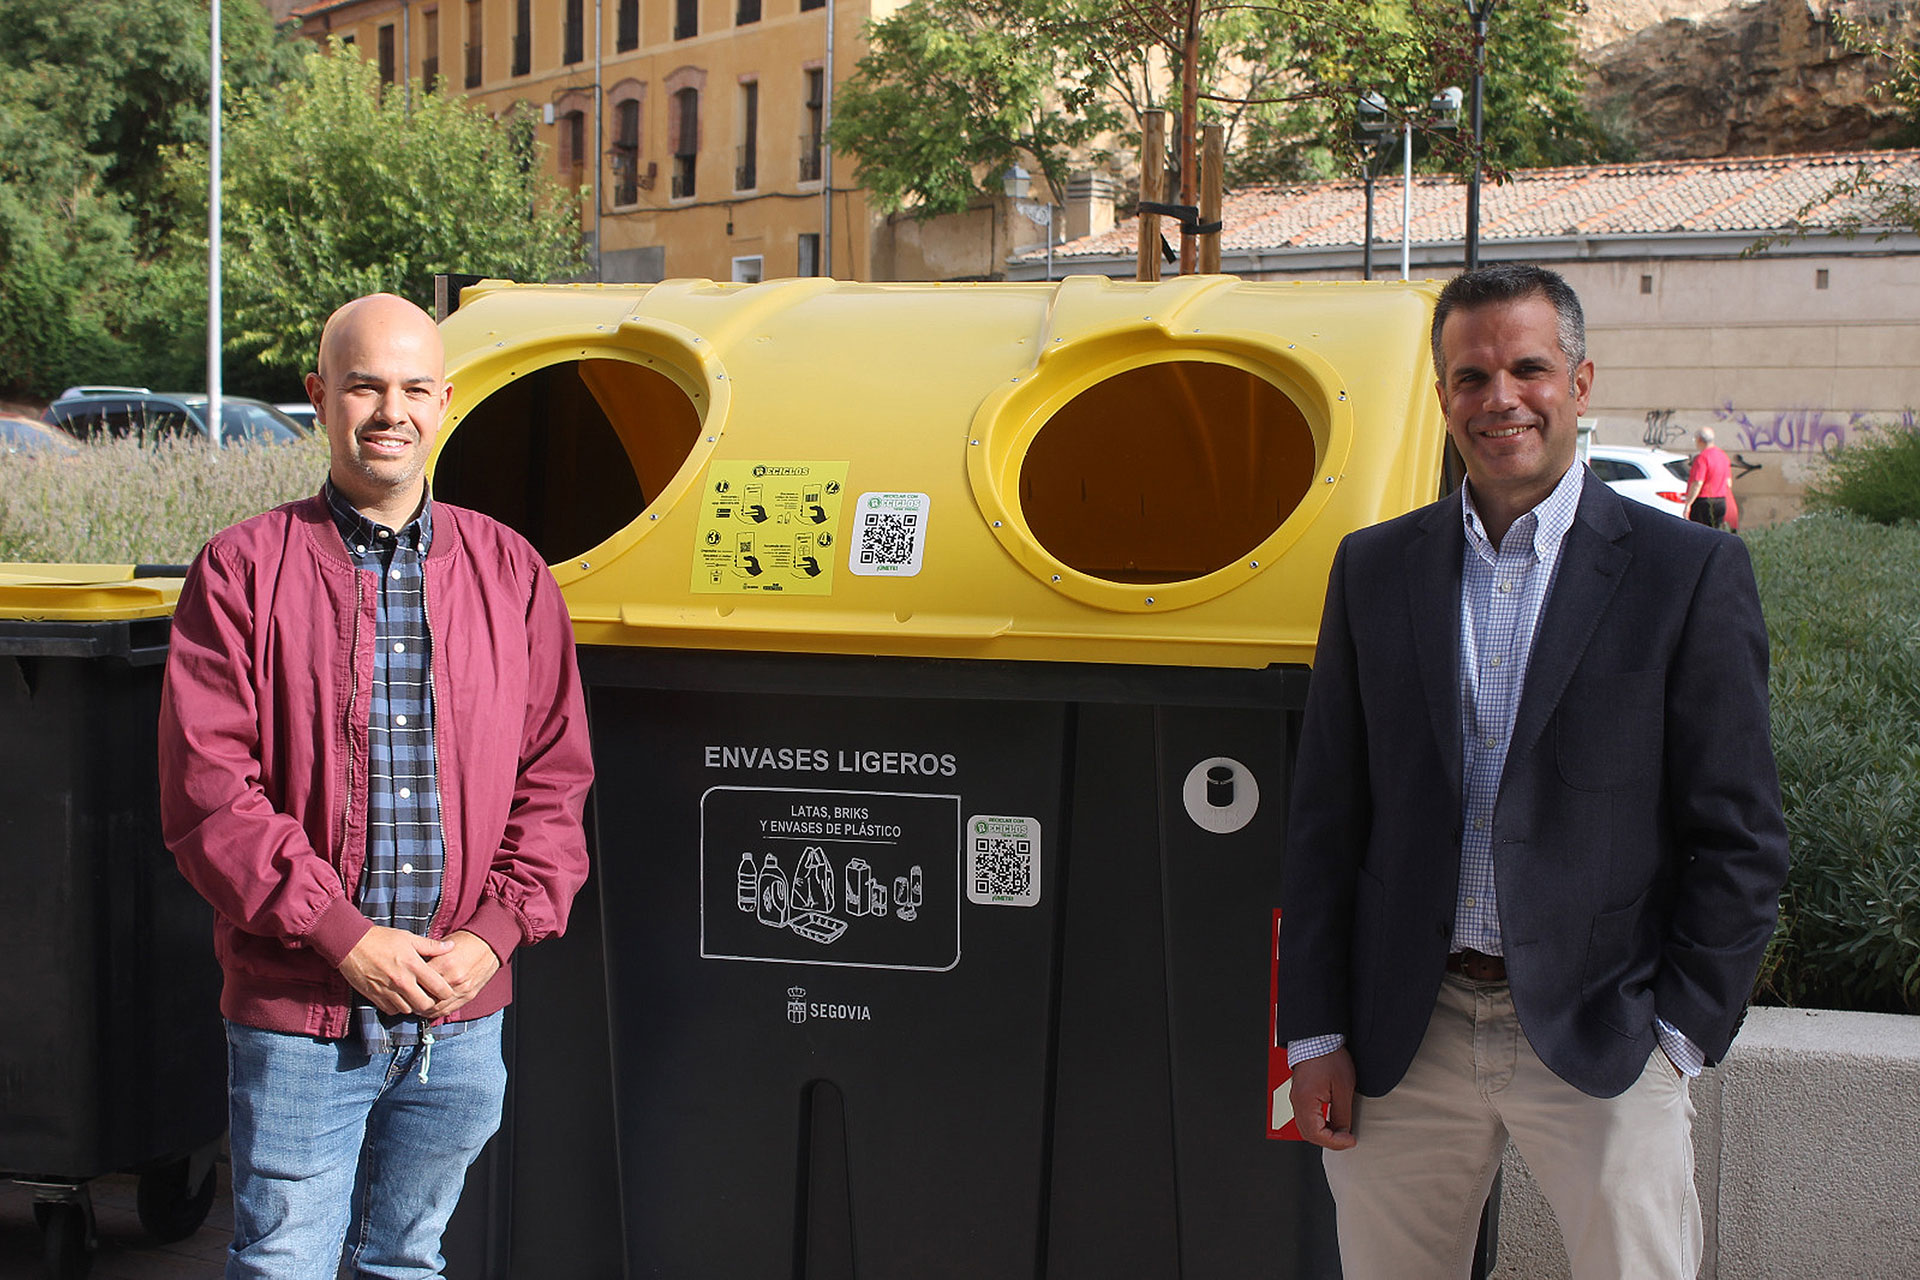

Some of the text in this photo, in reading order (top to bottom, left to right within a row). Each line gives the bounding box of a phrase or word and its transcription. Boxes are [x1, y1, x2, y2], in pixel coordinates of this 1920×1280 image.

[752, 465, 809, 477] RECICLOS
[704, 746, 957, 777] ENVASES LIGEROS
[791, 805, 869, 820] LATAS, BRIKS
[759, 820, 901, 837] Y ENVASES DE PLÁSTICO
[976, 821, 1028, 834] RECICLOS
[810, 1003, 871, 1020] SEGOVIA
